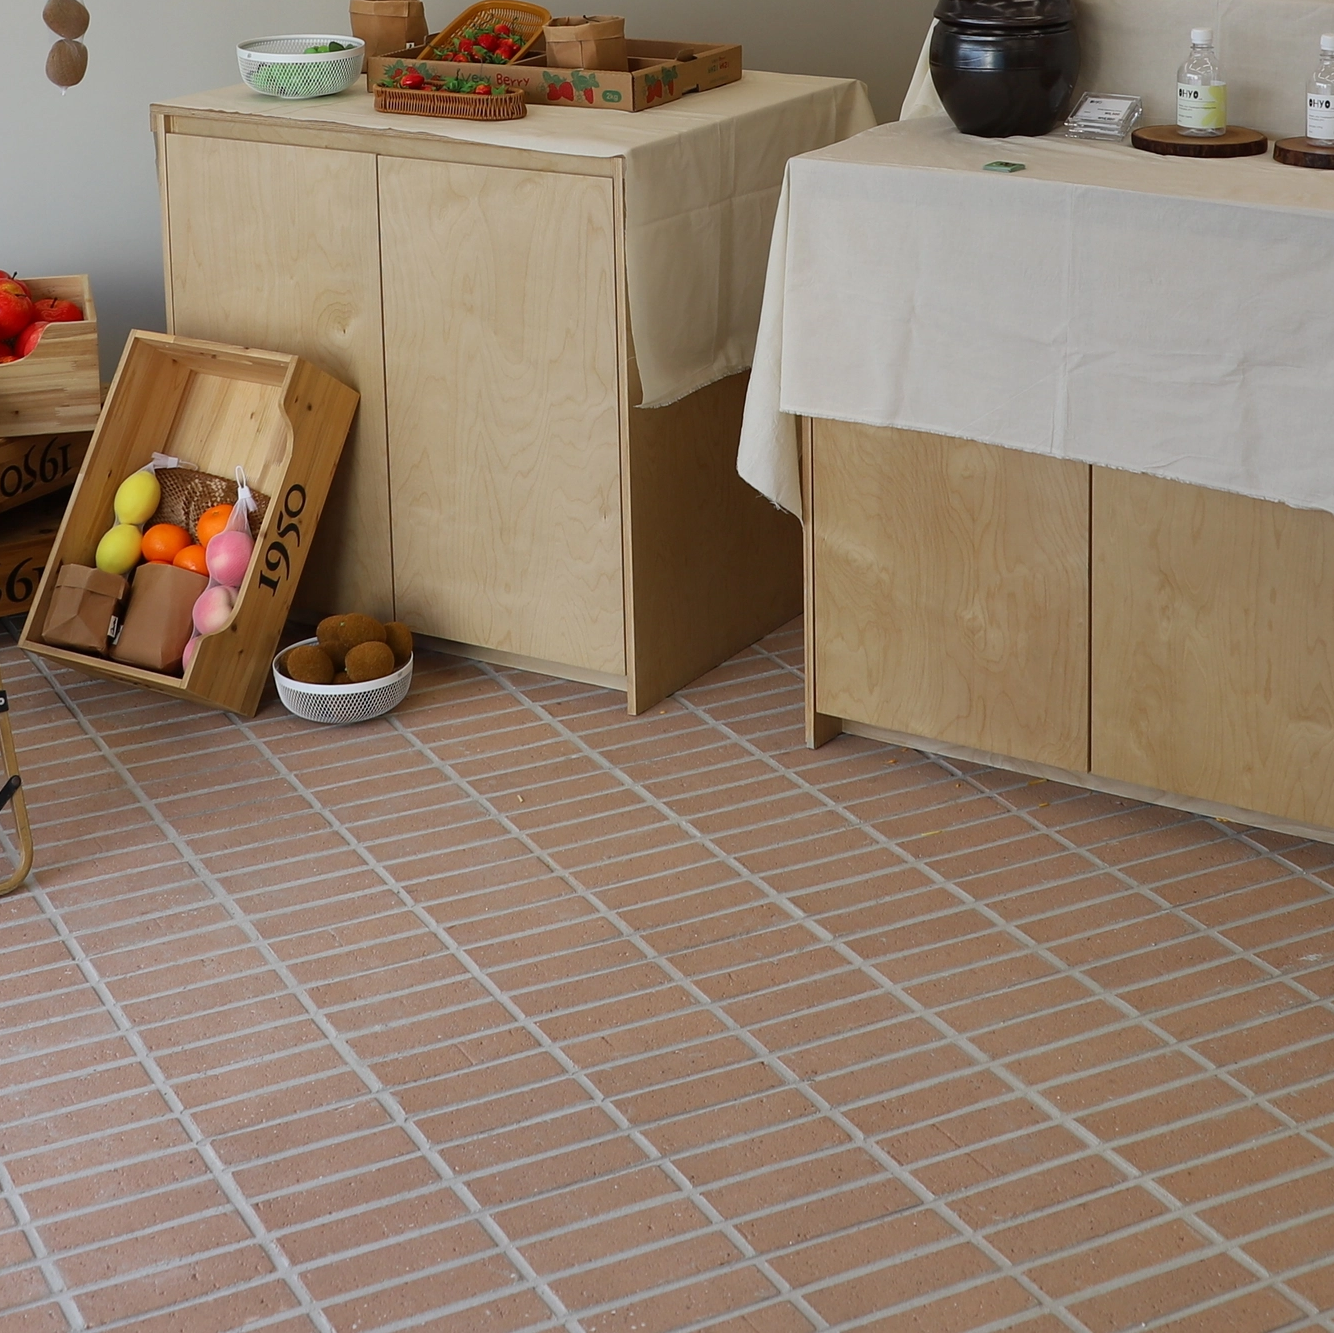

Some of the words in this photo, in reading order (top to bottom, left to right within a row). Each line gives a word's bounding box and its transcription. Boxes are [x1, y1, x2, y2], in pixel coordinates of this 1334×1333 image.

[496, 73, 530, 86] Berry
[1179, 88, 1199, 99] OHYO
[1309, 98, 1331, 109] OHYO
[260, 482, 308, 597] 1950
